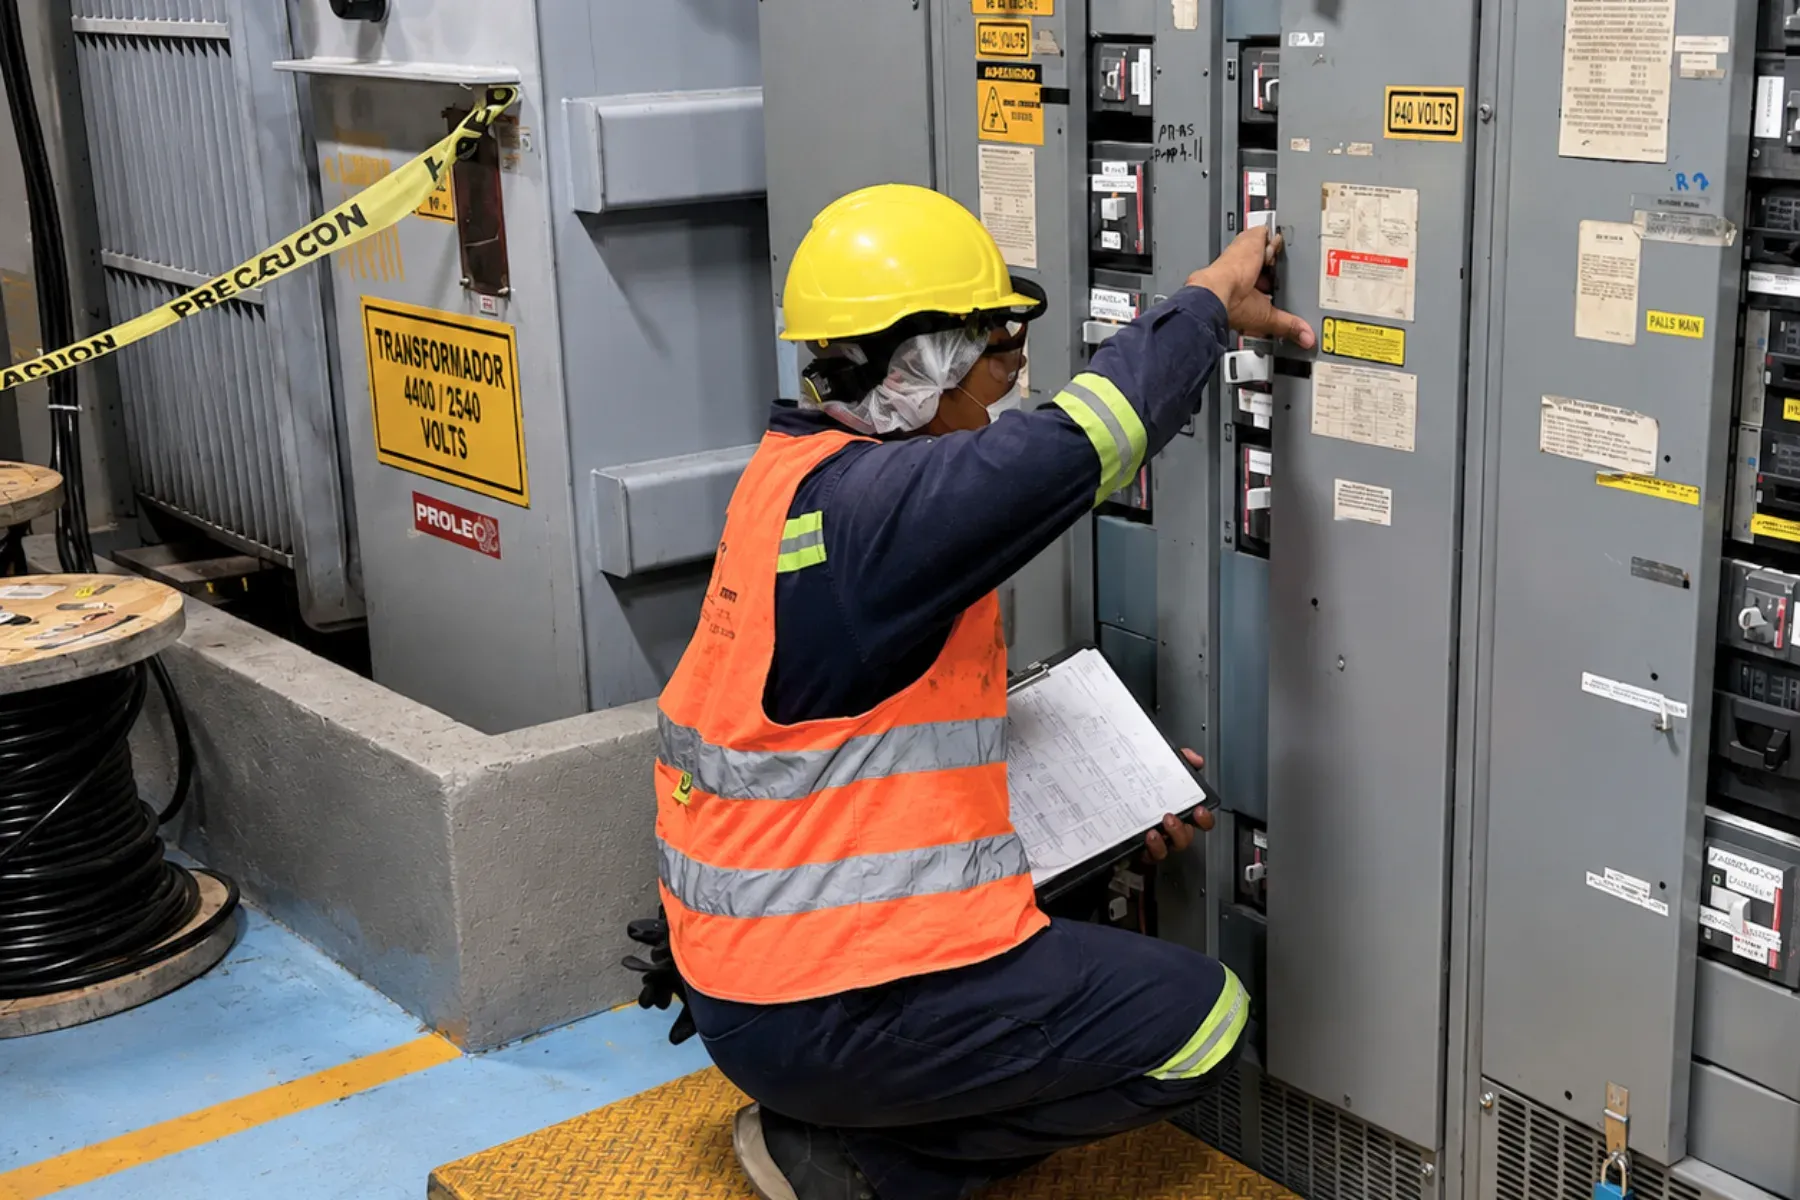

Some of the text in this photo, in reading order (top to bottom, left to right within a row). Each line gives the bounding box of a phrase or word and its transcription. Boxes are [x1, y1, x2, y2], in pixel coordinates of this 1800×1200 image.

[1417, 101, 1452, 125] VOLTS
[375, 327, 506, 390] TRANSFORMADOR
[404, 375, 436, 413] 4400
[446, 386, 481, 424] 2540
[421, 416, 468, 460] VOLTS
